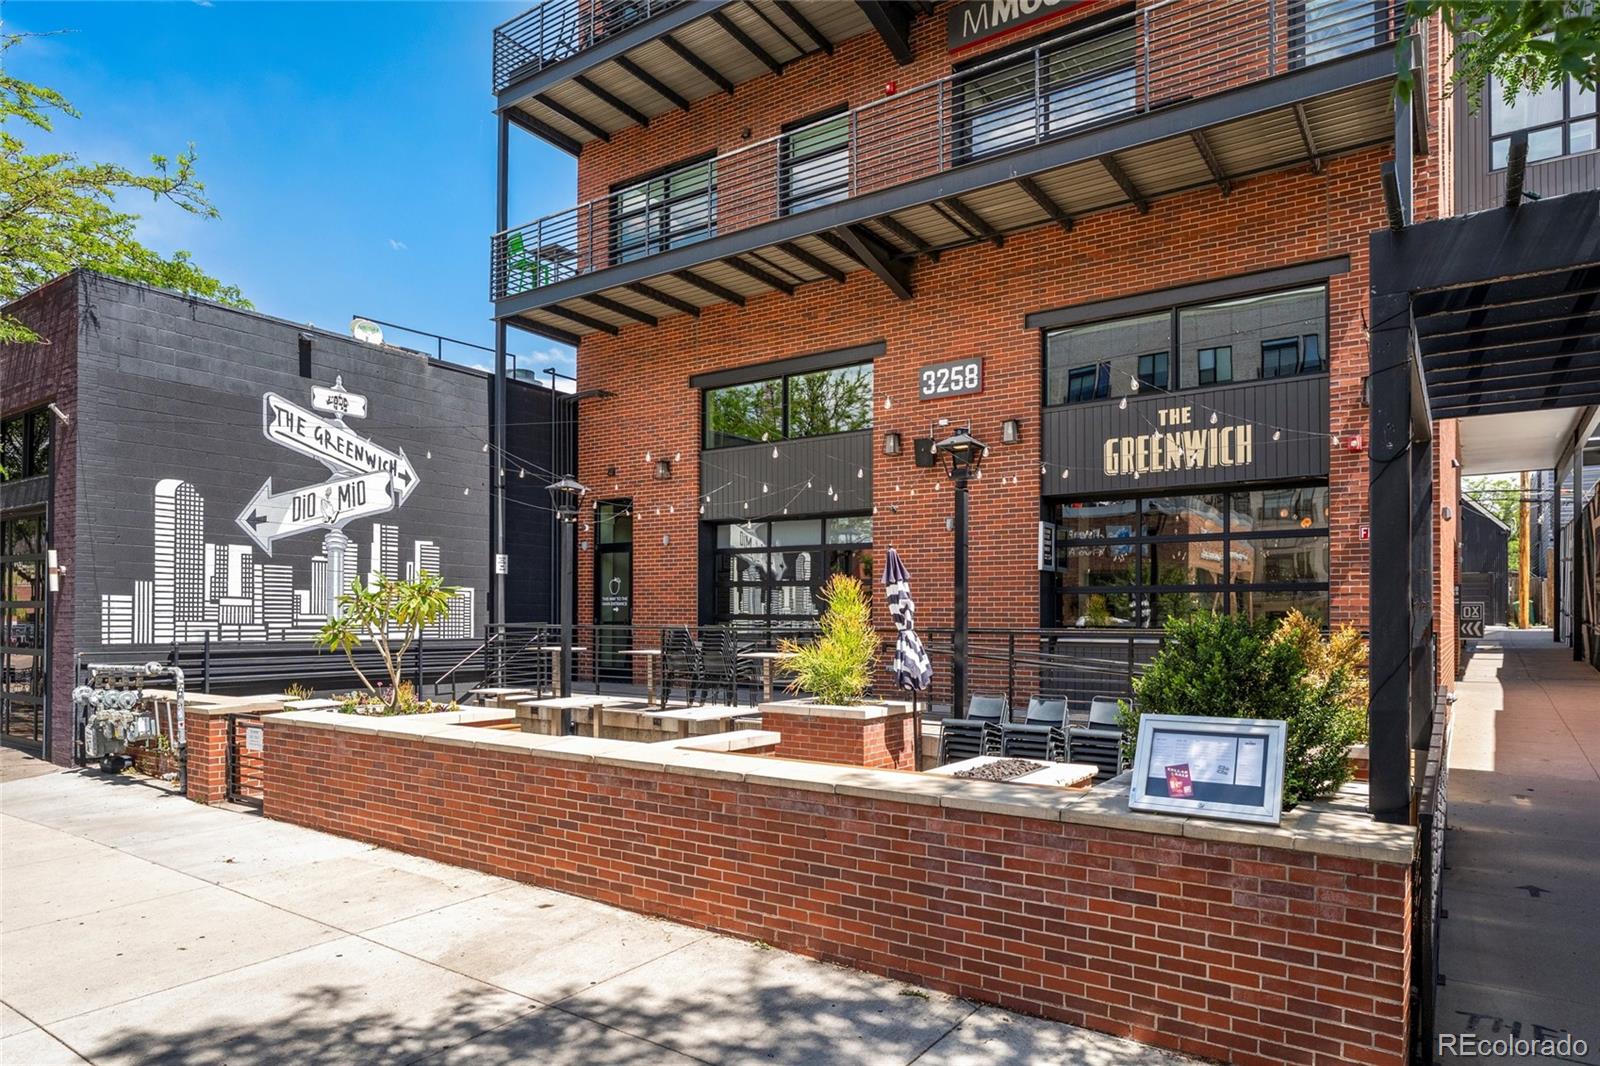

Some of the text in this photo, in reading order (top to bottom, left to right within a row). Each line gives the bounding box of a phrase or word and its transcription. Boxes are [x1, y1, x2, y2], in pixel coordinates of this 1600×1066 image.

[922, 363, 978, 395] 3258
[1158, 406, 1192, 427] THE
[274, 404, 398, 477] THE GREENWICH
[1103, 424, 1253, 477] GREENWICH
